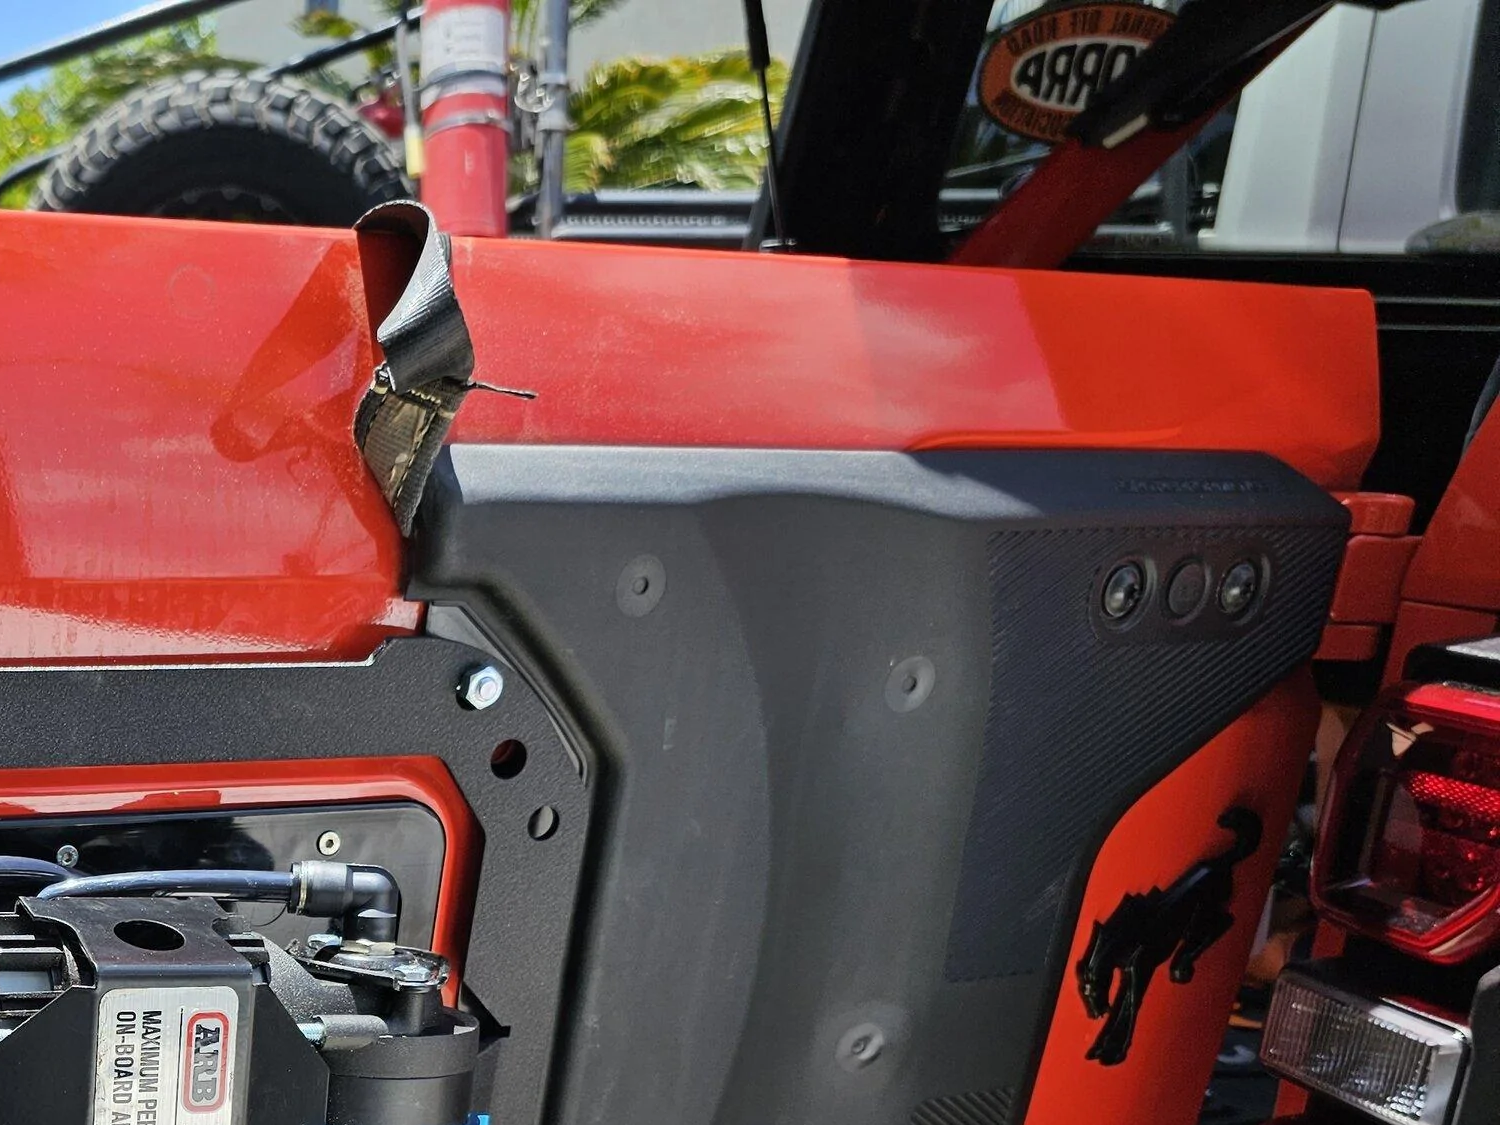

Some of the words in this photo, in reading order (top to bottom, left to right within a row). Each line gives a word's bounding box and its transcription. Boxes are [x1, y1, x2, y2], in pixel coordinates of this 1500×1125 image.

[112, 1010, 138, 1105] ON-BOARD
[136, 1009, 163, 1094] MAXIMUM
[190, 1023, 222, 1104] ARB
